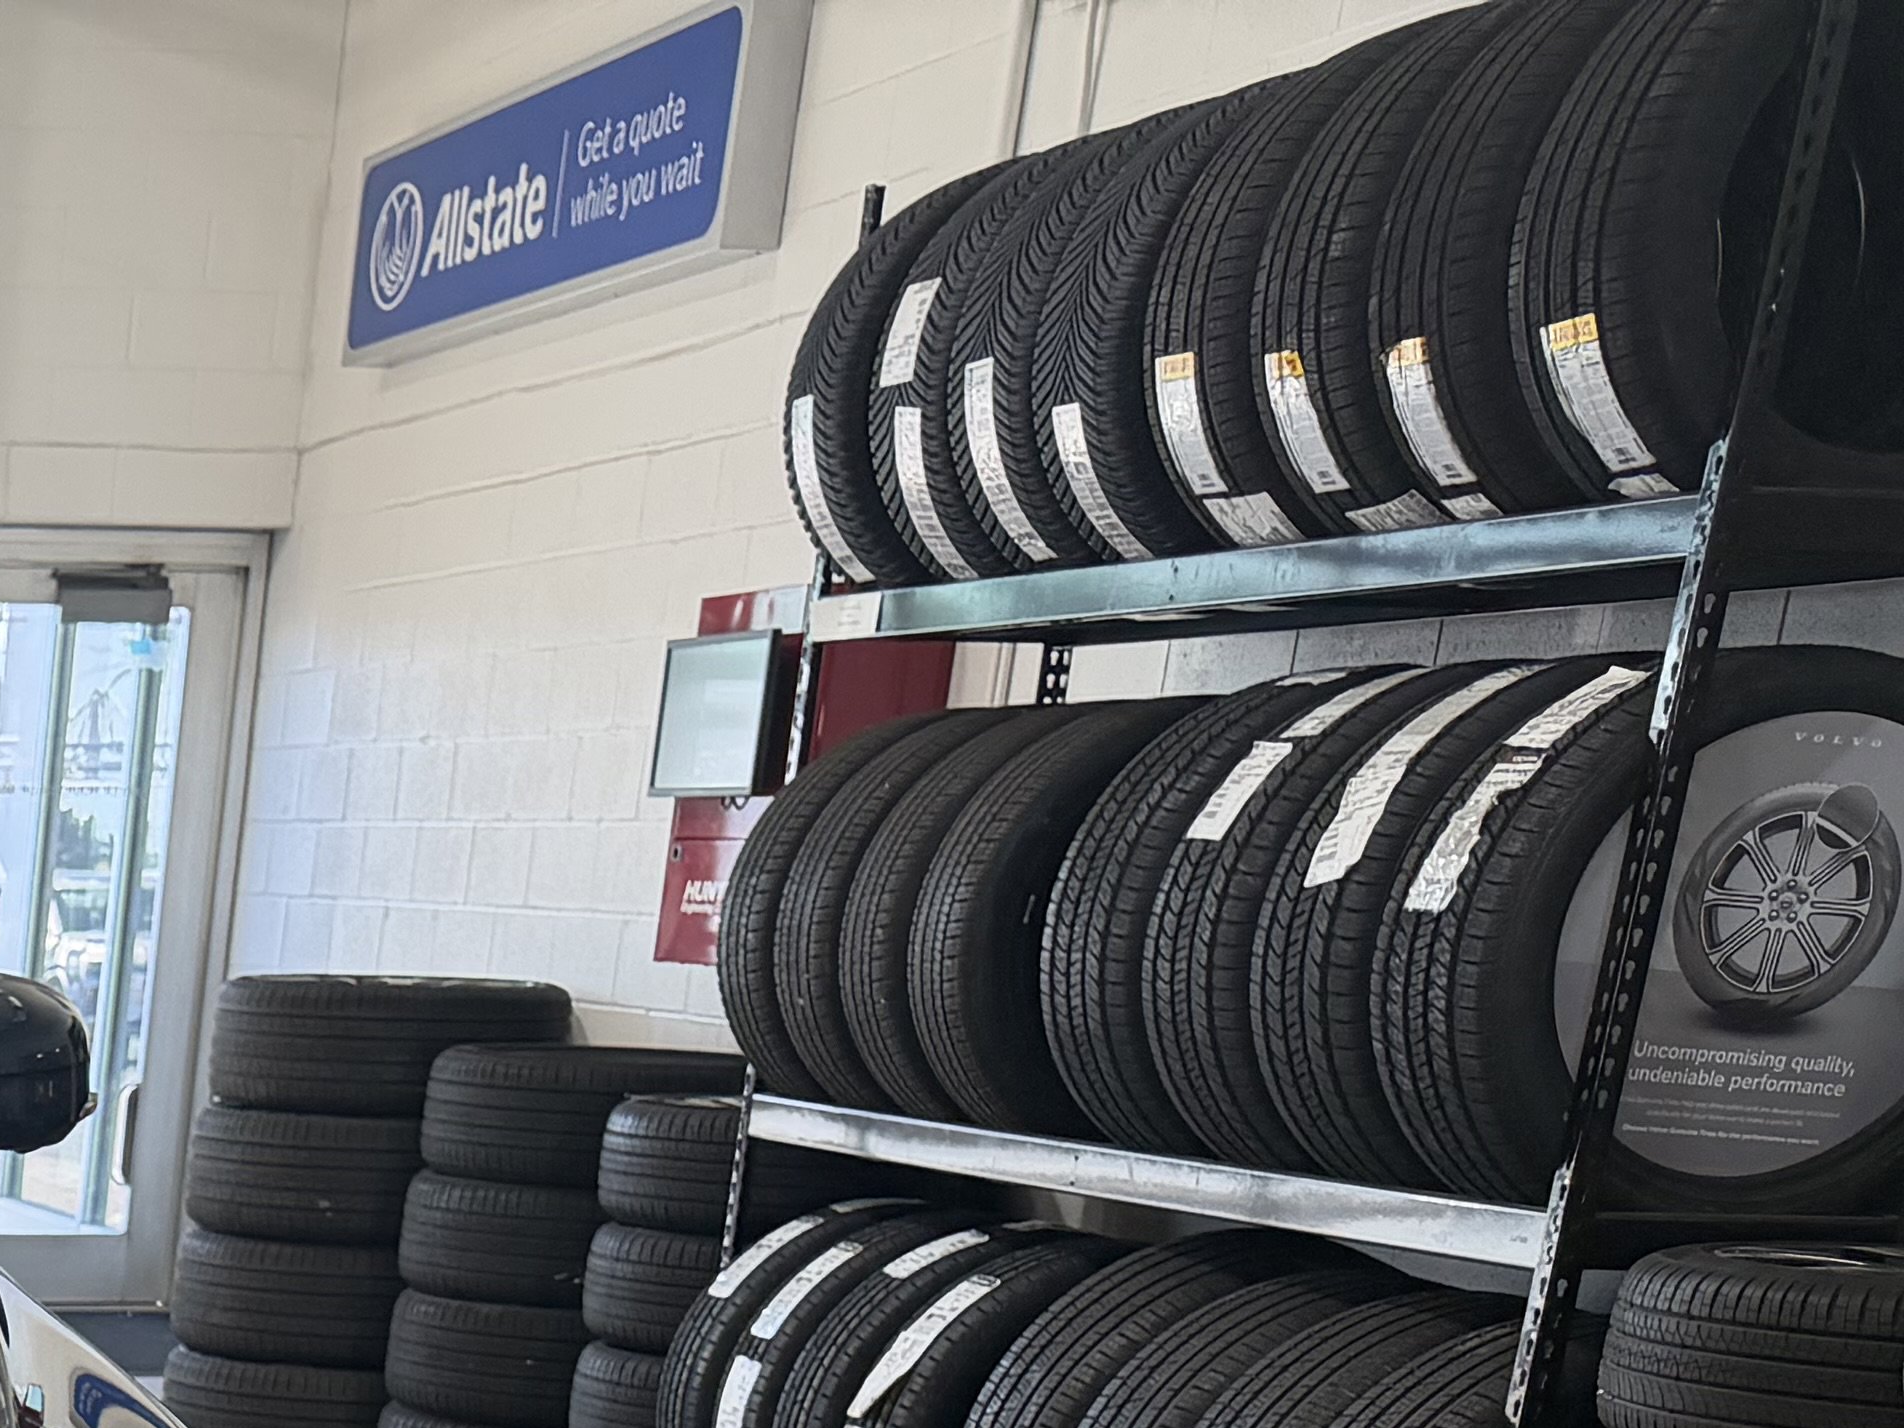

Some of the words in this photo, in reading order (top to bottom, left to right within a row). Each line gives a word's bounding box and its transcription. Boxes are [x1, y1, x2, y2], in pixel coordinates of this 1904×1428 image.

[578, 117, 612, 167] Get
[613, 120, 627, 154] a
[629, 91, 686, 156] quote
[571, 172, 618, 227] while
[619, 168, 657, 221] you
[661, 141, 704, 196] wait
[421, 162, 547, 277] Allstate
[1794, 731, 1882, 748] VOLVO
[1628, 1066, 1725, 1088] undeniable
[1728, 1073, 1846, 1097] performance
[1633, 1040, 1787, 1072] Uncompromising
[1791, 1055, 1855, 1078] quality,
